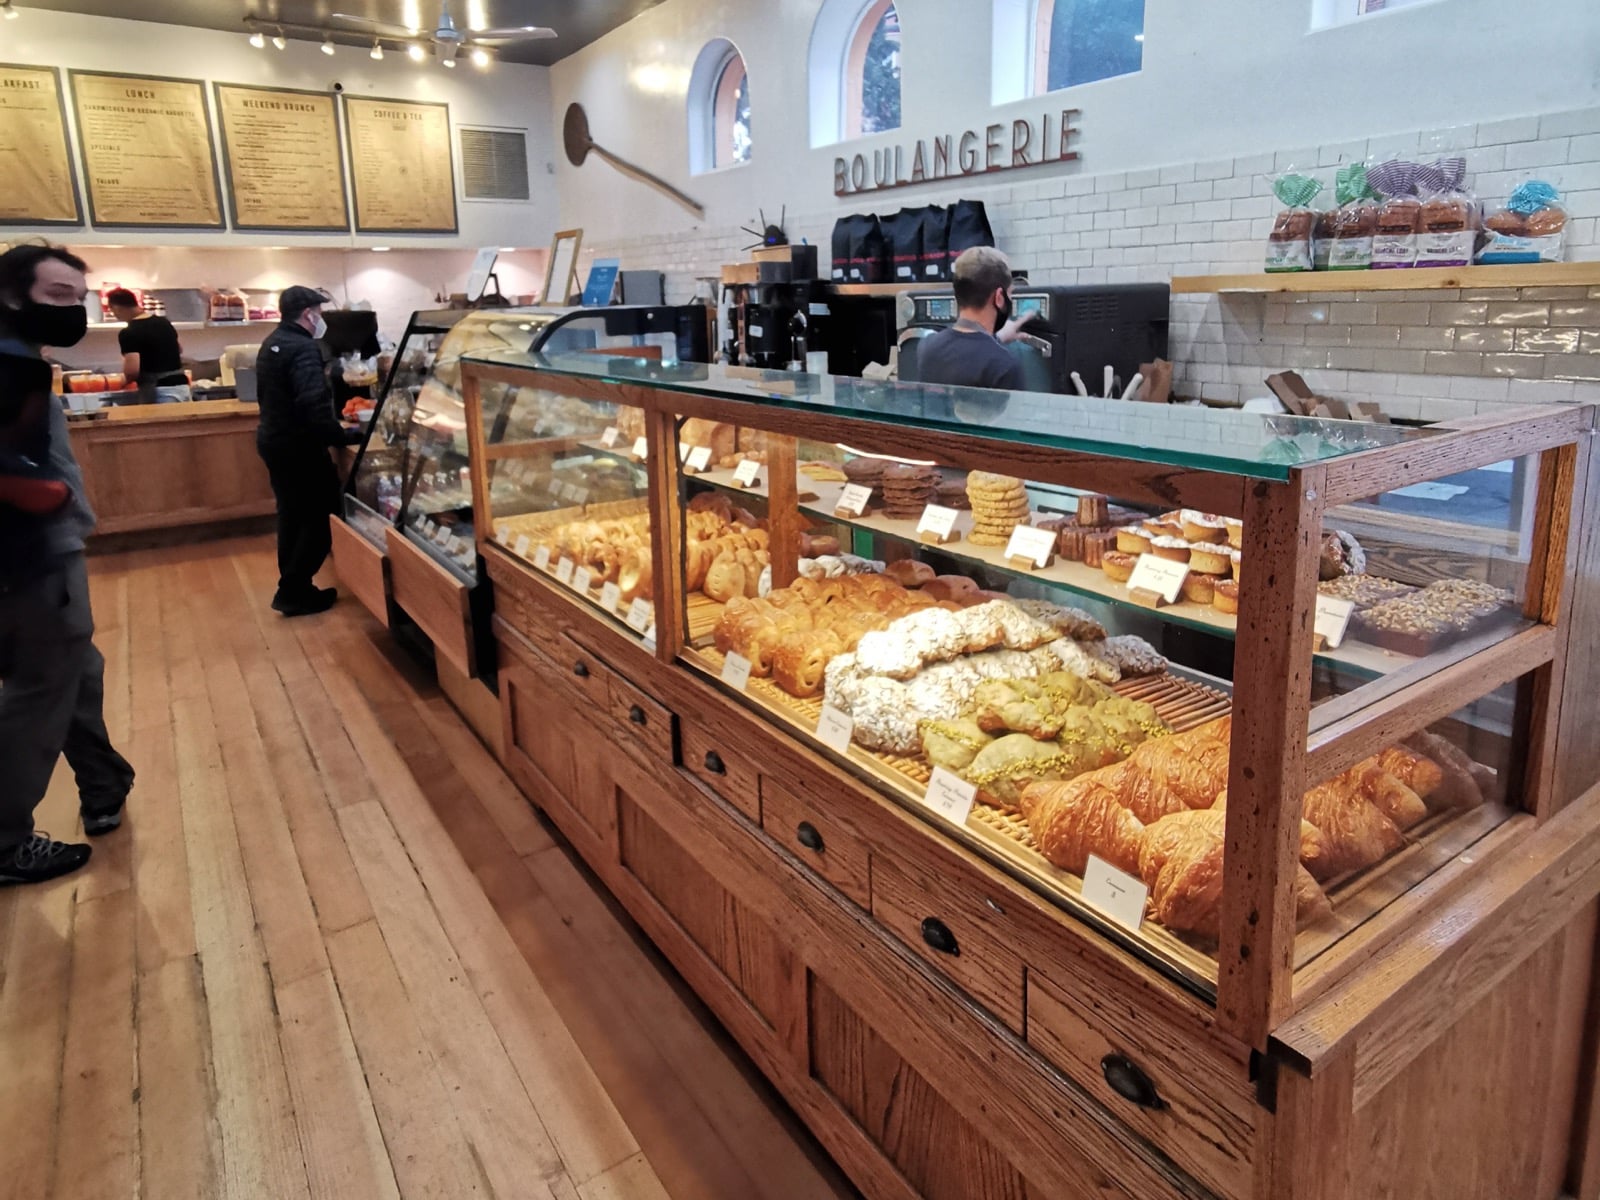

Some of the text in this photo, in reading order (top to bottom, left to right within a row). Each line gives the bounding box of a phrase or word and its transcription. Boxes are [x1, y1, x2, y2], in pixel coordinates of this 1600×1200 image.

[125, 88, 156, 99] LUNCH
[242, 99, 316, 112] WEEKEND BRUNCH
[373, 110, 400, 120] COFFEE
[409, 113, 423, 121] TEA
[834, 108, 1082, 197] BOULANGERIE
